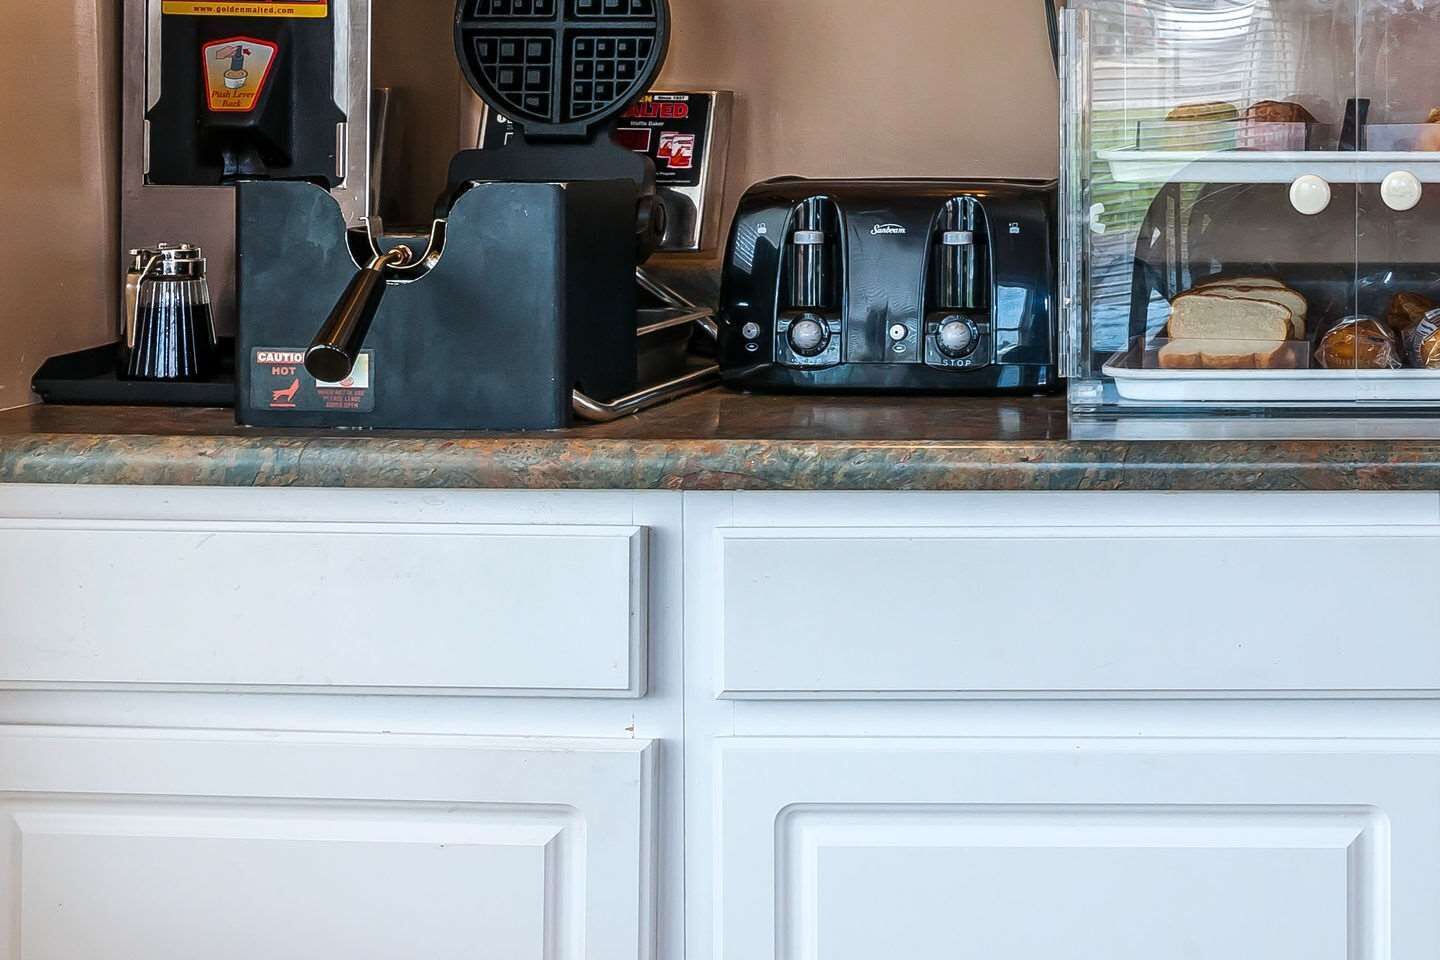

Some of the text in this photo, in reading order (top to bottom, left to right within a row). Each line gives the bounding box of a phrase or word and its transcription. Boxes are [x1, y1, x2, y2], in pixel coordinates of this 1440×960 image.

[192, 5, 294, 16] www.goldenmalted.com
[624, 102, 688, 118] ALTED
[870, 224, 907, 235] Sunbeam
[257, 352, 305, 362] CAUTIO
[942, 359, 972, 367] STOP
[272, 366, 297, 376] HOT
